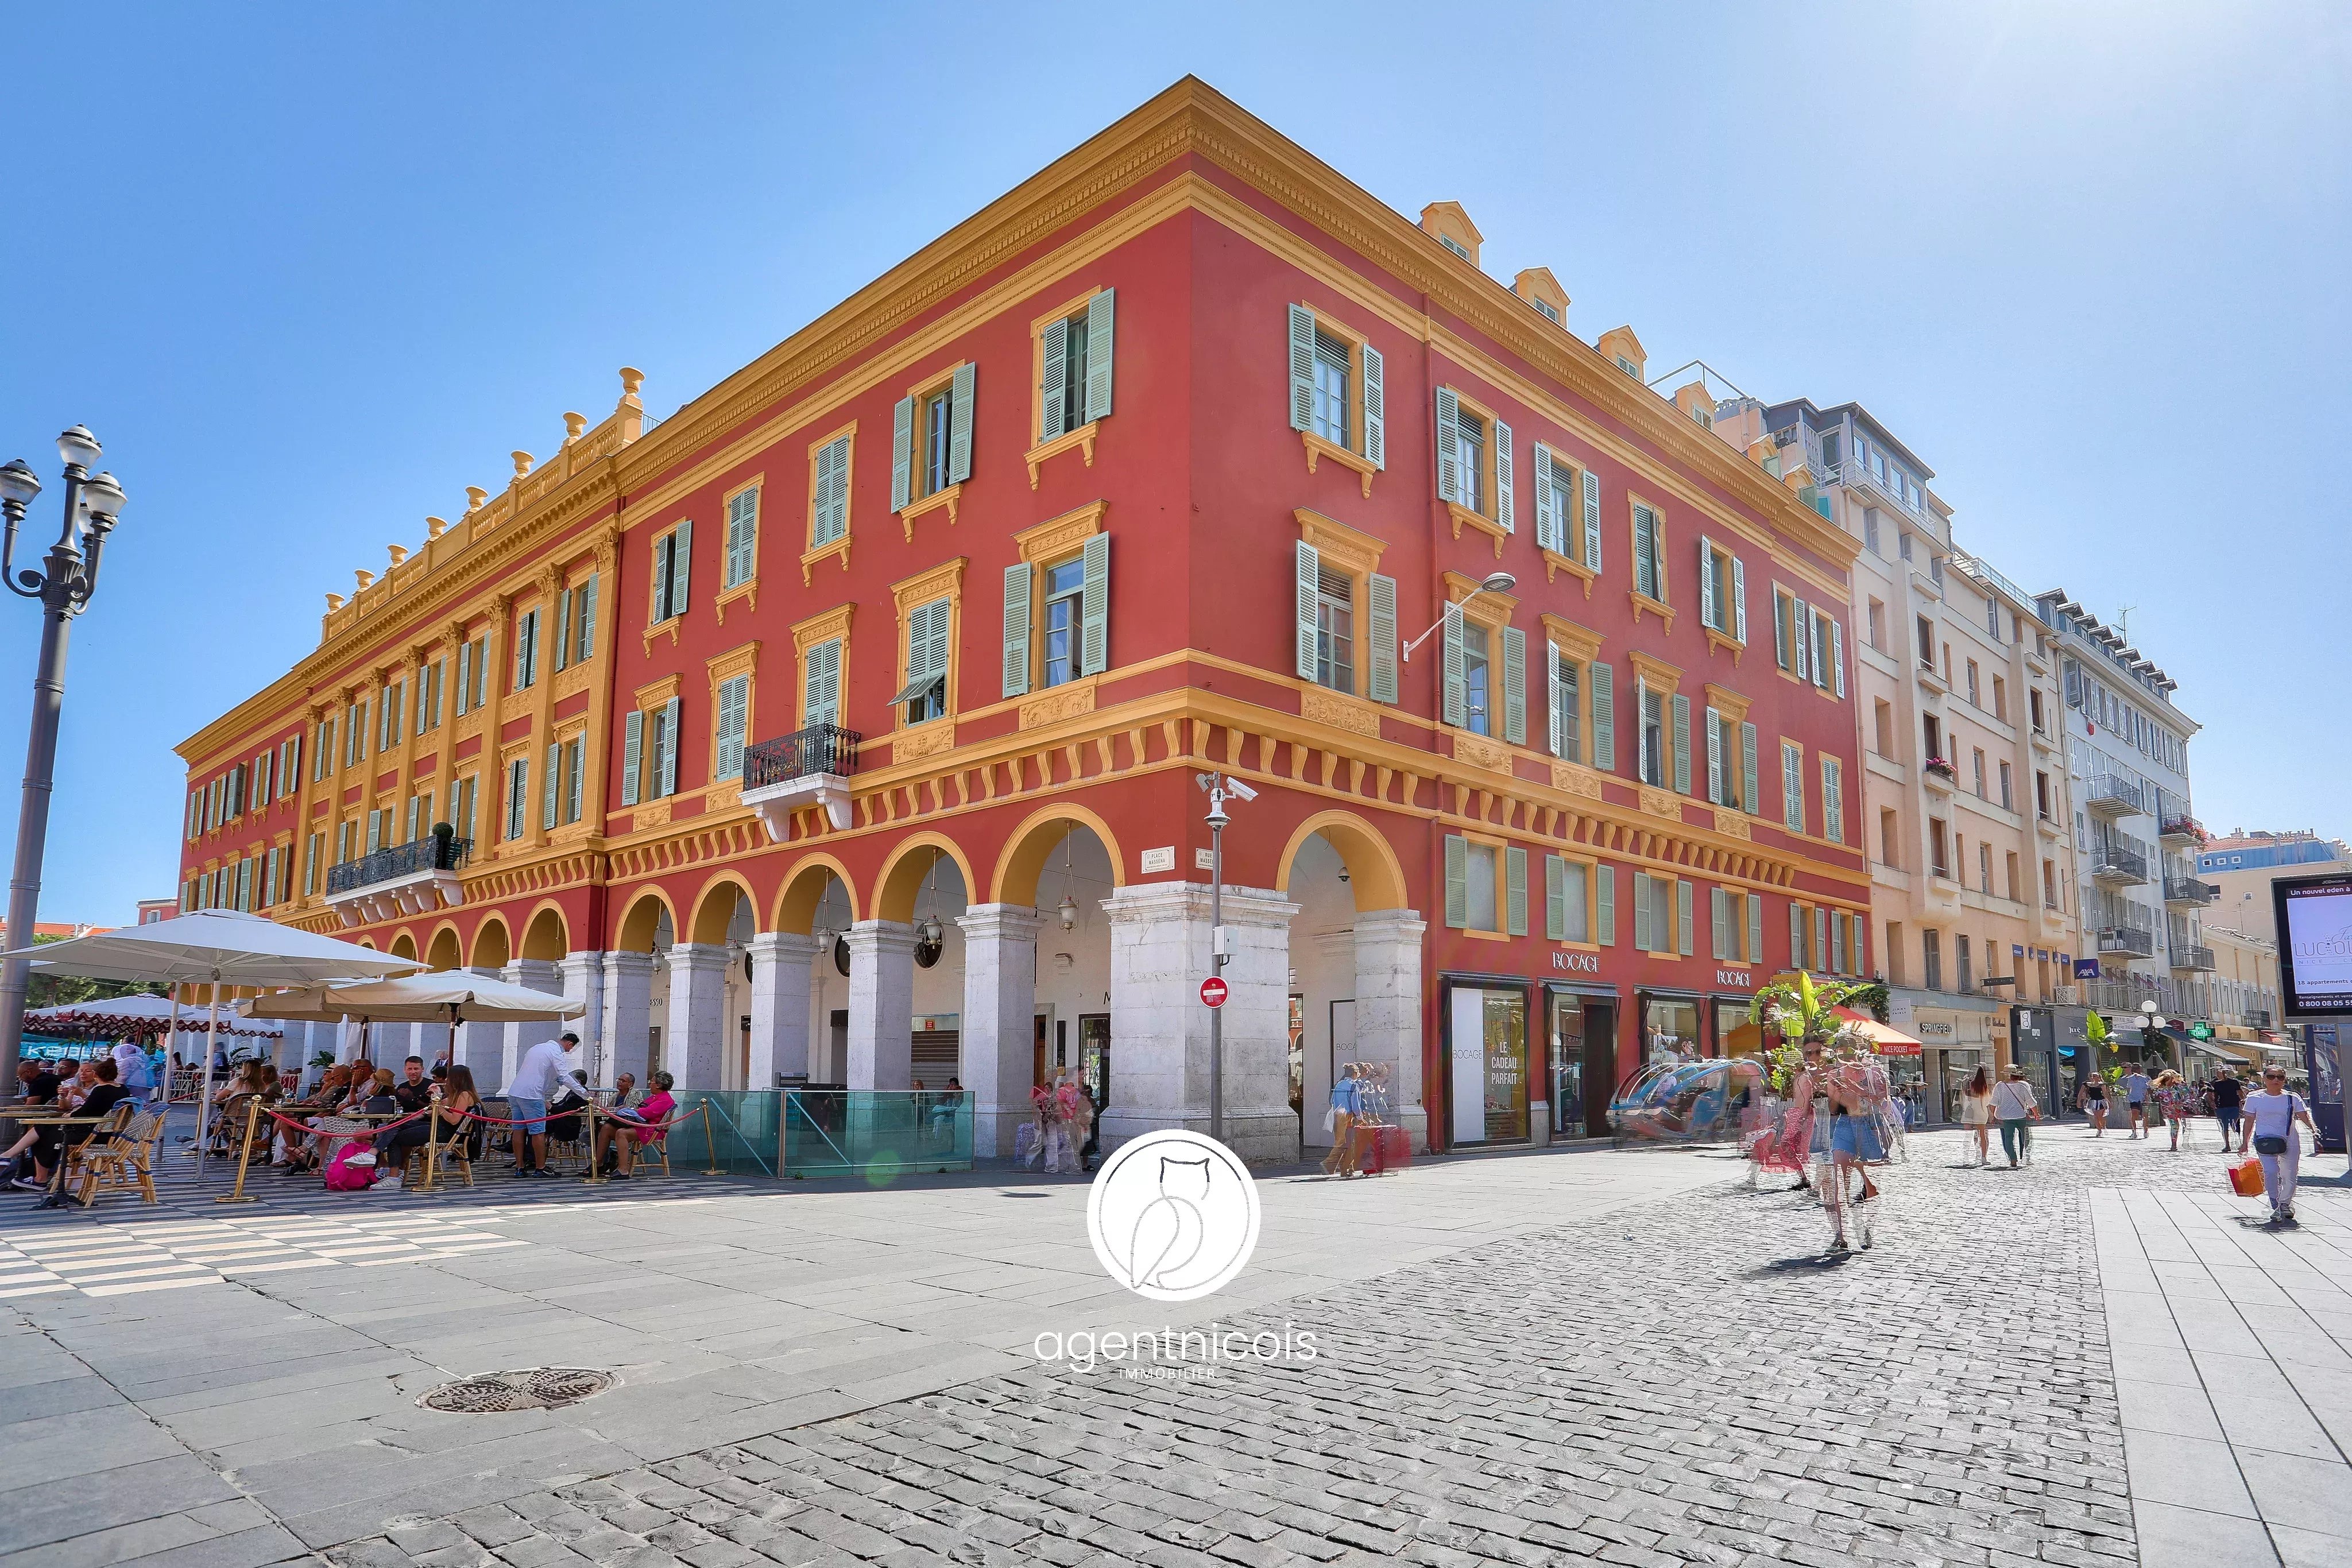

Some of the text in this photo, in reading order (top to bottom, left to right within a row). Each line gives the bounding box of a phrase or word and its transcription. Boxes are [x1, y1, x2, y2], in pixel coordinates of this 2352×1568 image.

[1553, 951, 1600, 973] BOCAGE
[1717, 969, 1751, 988] BOCAGE
[2078, 969, 2095, 977] AXA
[1774, 978, 1801, 986] BOCAG
[1921, 1023, 1953, 1034] SPRINGFIELD
[1500, 1042, 1507, 1053] LE
[1453, 1050, 1482, 1059] BOCAGE
[1491, 1056, 1518, 1069] CADEAU
[1491, 1073, 1518, 1085] PARFAIT
